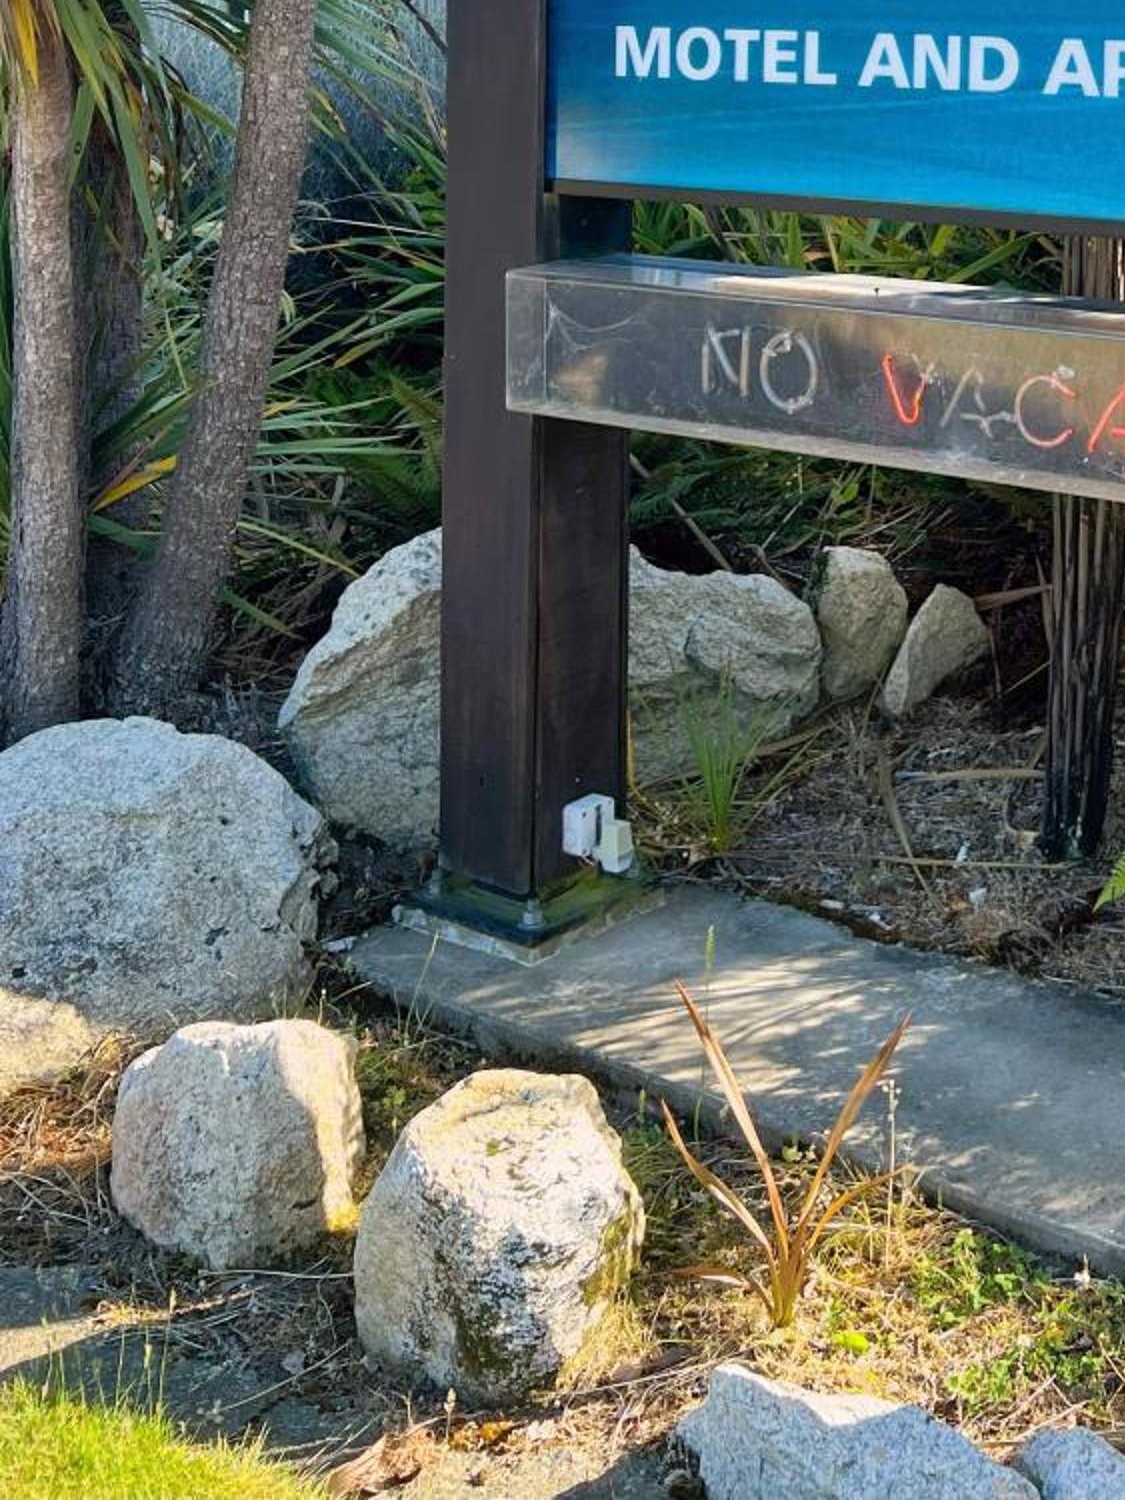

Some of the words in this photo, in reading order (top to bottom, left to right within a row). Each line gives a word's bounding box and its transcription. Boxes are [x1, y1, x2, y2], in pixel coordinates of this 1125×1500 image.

[613, 24, 838, 85] MOTEL
[857, 33, 1020, 94] AND
[702, 323, 817, 413] NO
